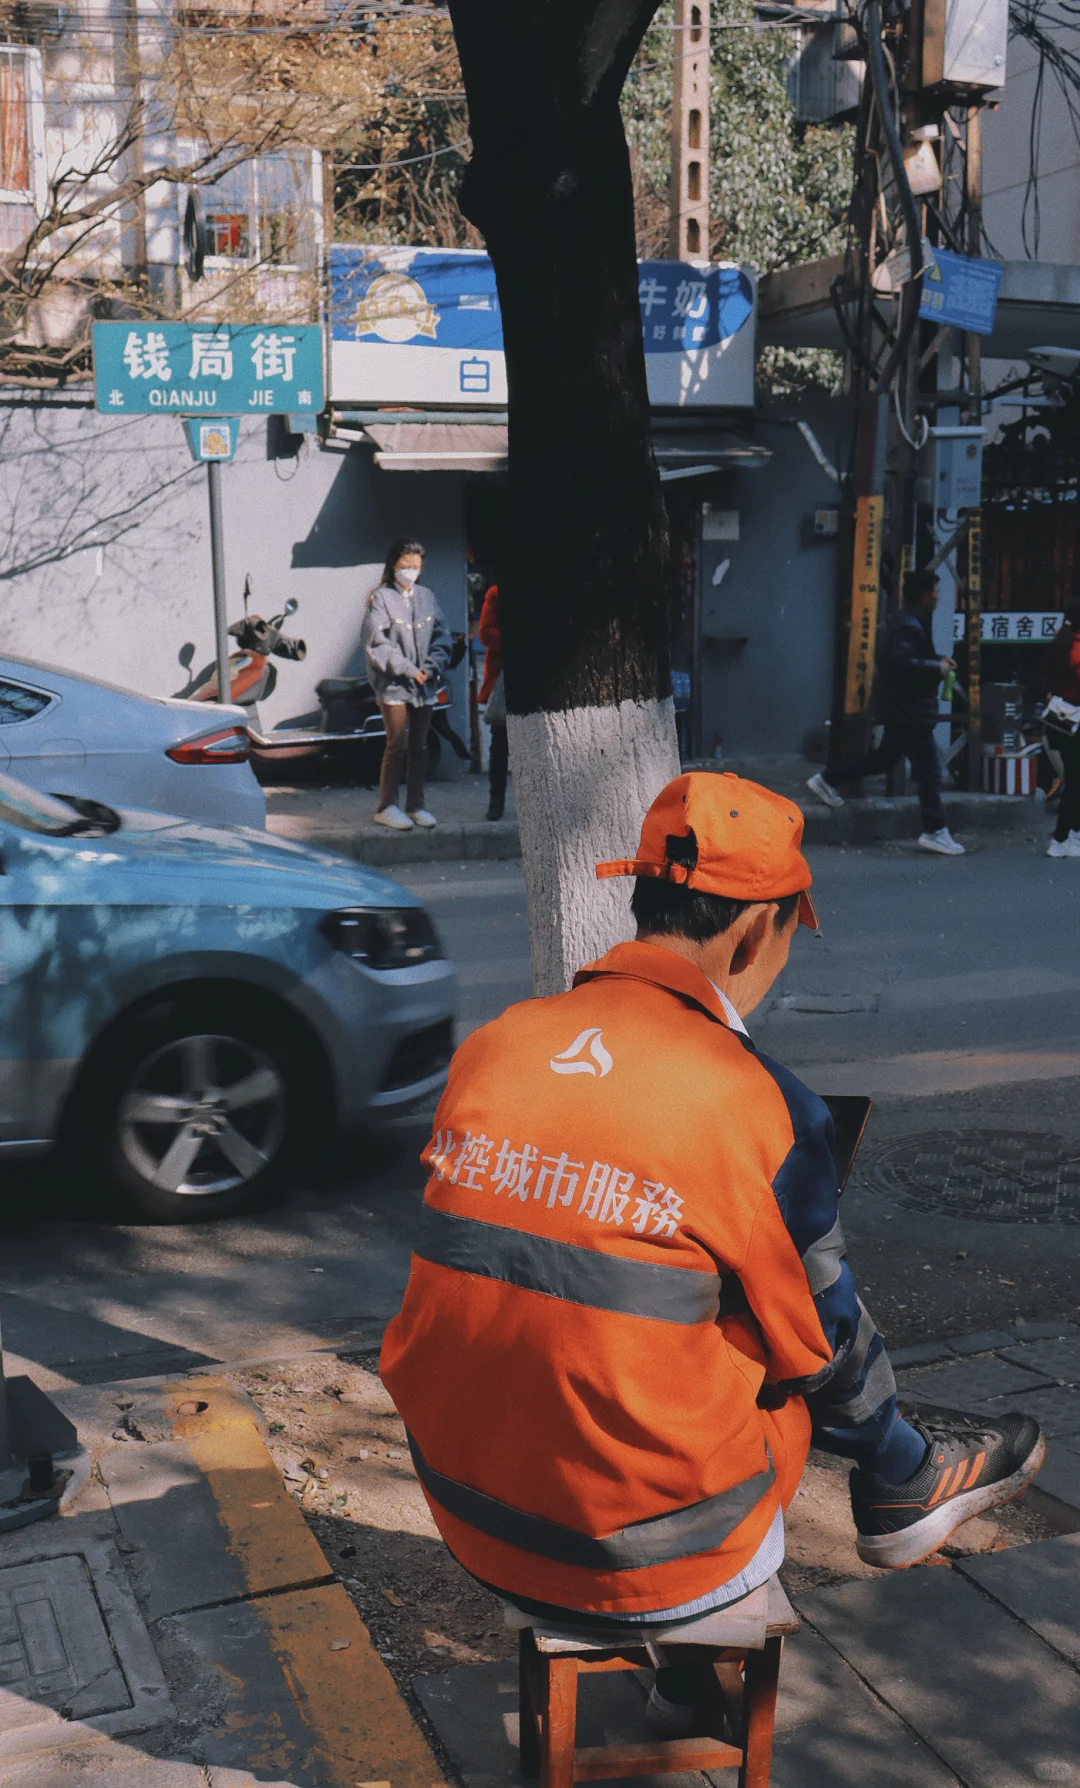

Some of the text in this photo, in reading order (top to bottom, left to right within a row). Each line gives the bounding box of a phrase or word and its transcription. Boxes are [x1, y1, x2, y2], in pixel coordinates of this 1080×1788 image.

[638, 278, 708, 318] 牛奶
[123, 331, 296, 381] 钱局街
[460, 356, 490, 393] 白
[108, 389, 124, 406] 北
[149, 389, 273, 406] QIANJU JIE
[298, 390, 312, 405] 南
